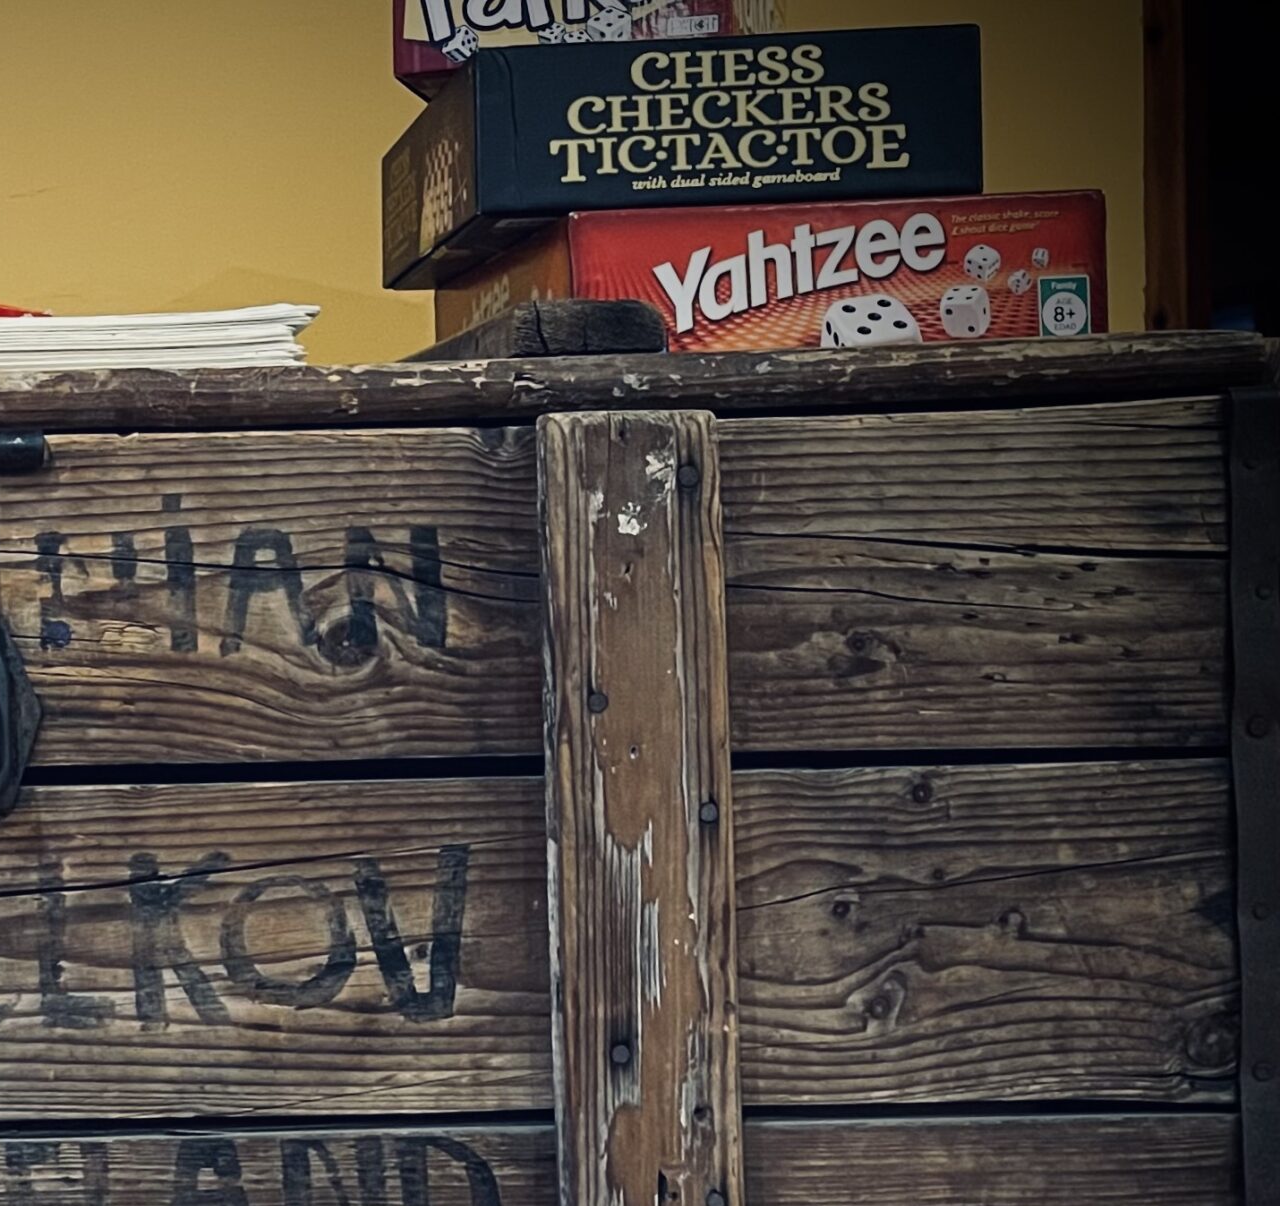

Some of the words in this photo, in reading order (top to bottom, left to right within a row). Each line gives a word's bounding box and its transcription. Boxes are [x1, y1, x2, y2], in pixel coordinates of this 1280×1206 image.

[630, 44, 825, 91] CHESS
[566, 82, 892, 135] CHECKERS
[632, 177, 667, 190] with
[670, 174, 705, 188] dual
[708, 172, 750, 187] sided
[752, 168, 841, 188] gameboard
[652, 211, 947, 336] Yahtzee
[1053, 306, 1076, 323] 8+
